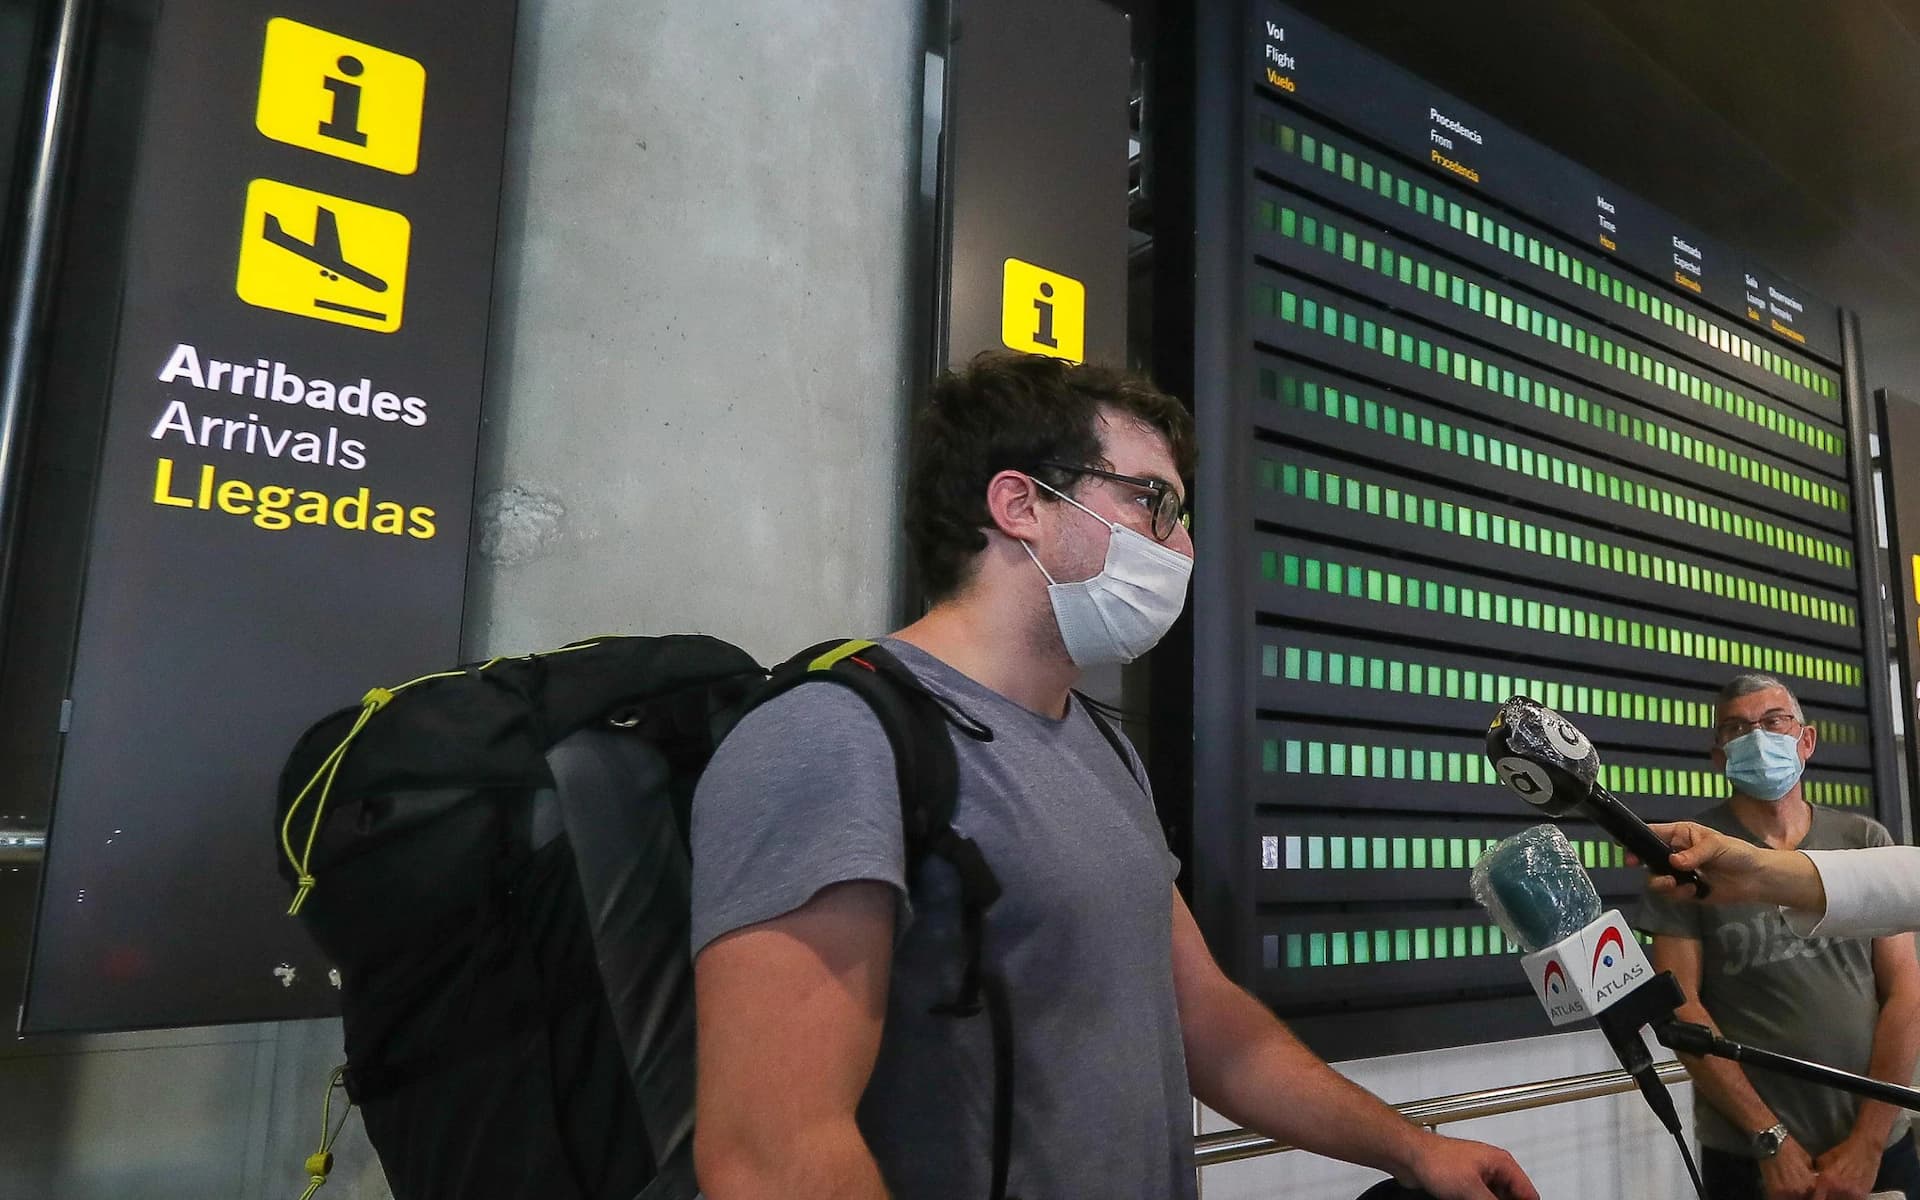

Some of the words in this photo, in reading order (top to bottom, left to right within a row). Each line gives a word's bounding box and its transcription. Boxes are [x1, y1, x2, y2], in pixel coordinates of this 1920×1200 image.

[1266, 20, 1284, 41] Vol
[1265, 43, 1296, 70] Flight
[1266, 67, 1296, 92] Vuelo
[1430, 107, 1483, 145] Procedencia
[1430, 129, 1453, 150] From
[158, 343, 428, 427] Arribades
[151, 400, 367, 470] Arrivals
[153, 458, 437, 539] Llegadas
[1596, 963, 1644, 1002] ATLAS
[1550, 1001, 1583, 1020] ATLAS
